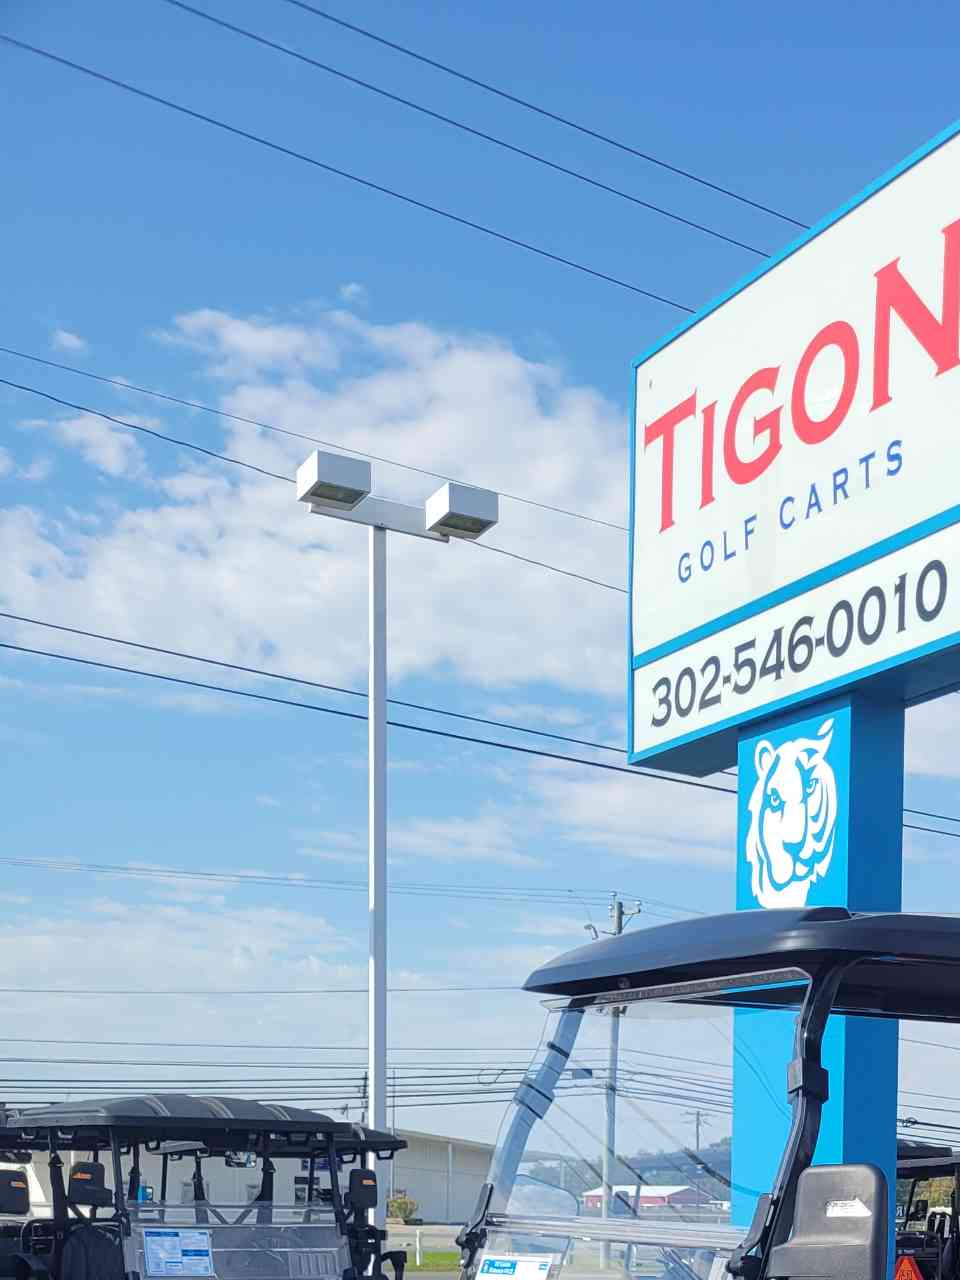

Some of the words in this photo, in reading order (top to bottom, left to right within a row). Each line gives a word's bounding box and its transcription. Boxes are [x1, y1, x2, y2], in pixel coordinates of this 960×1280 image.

[678, 515, 758, 583] GOLF
[778, 439, 904, 529] CARTS
[650, 560, 948, 728] 302-546-0010
